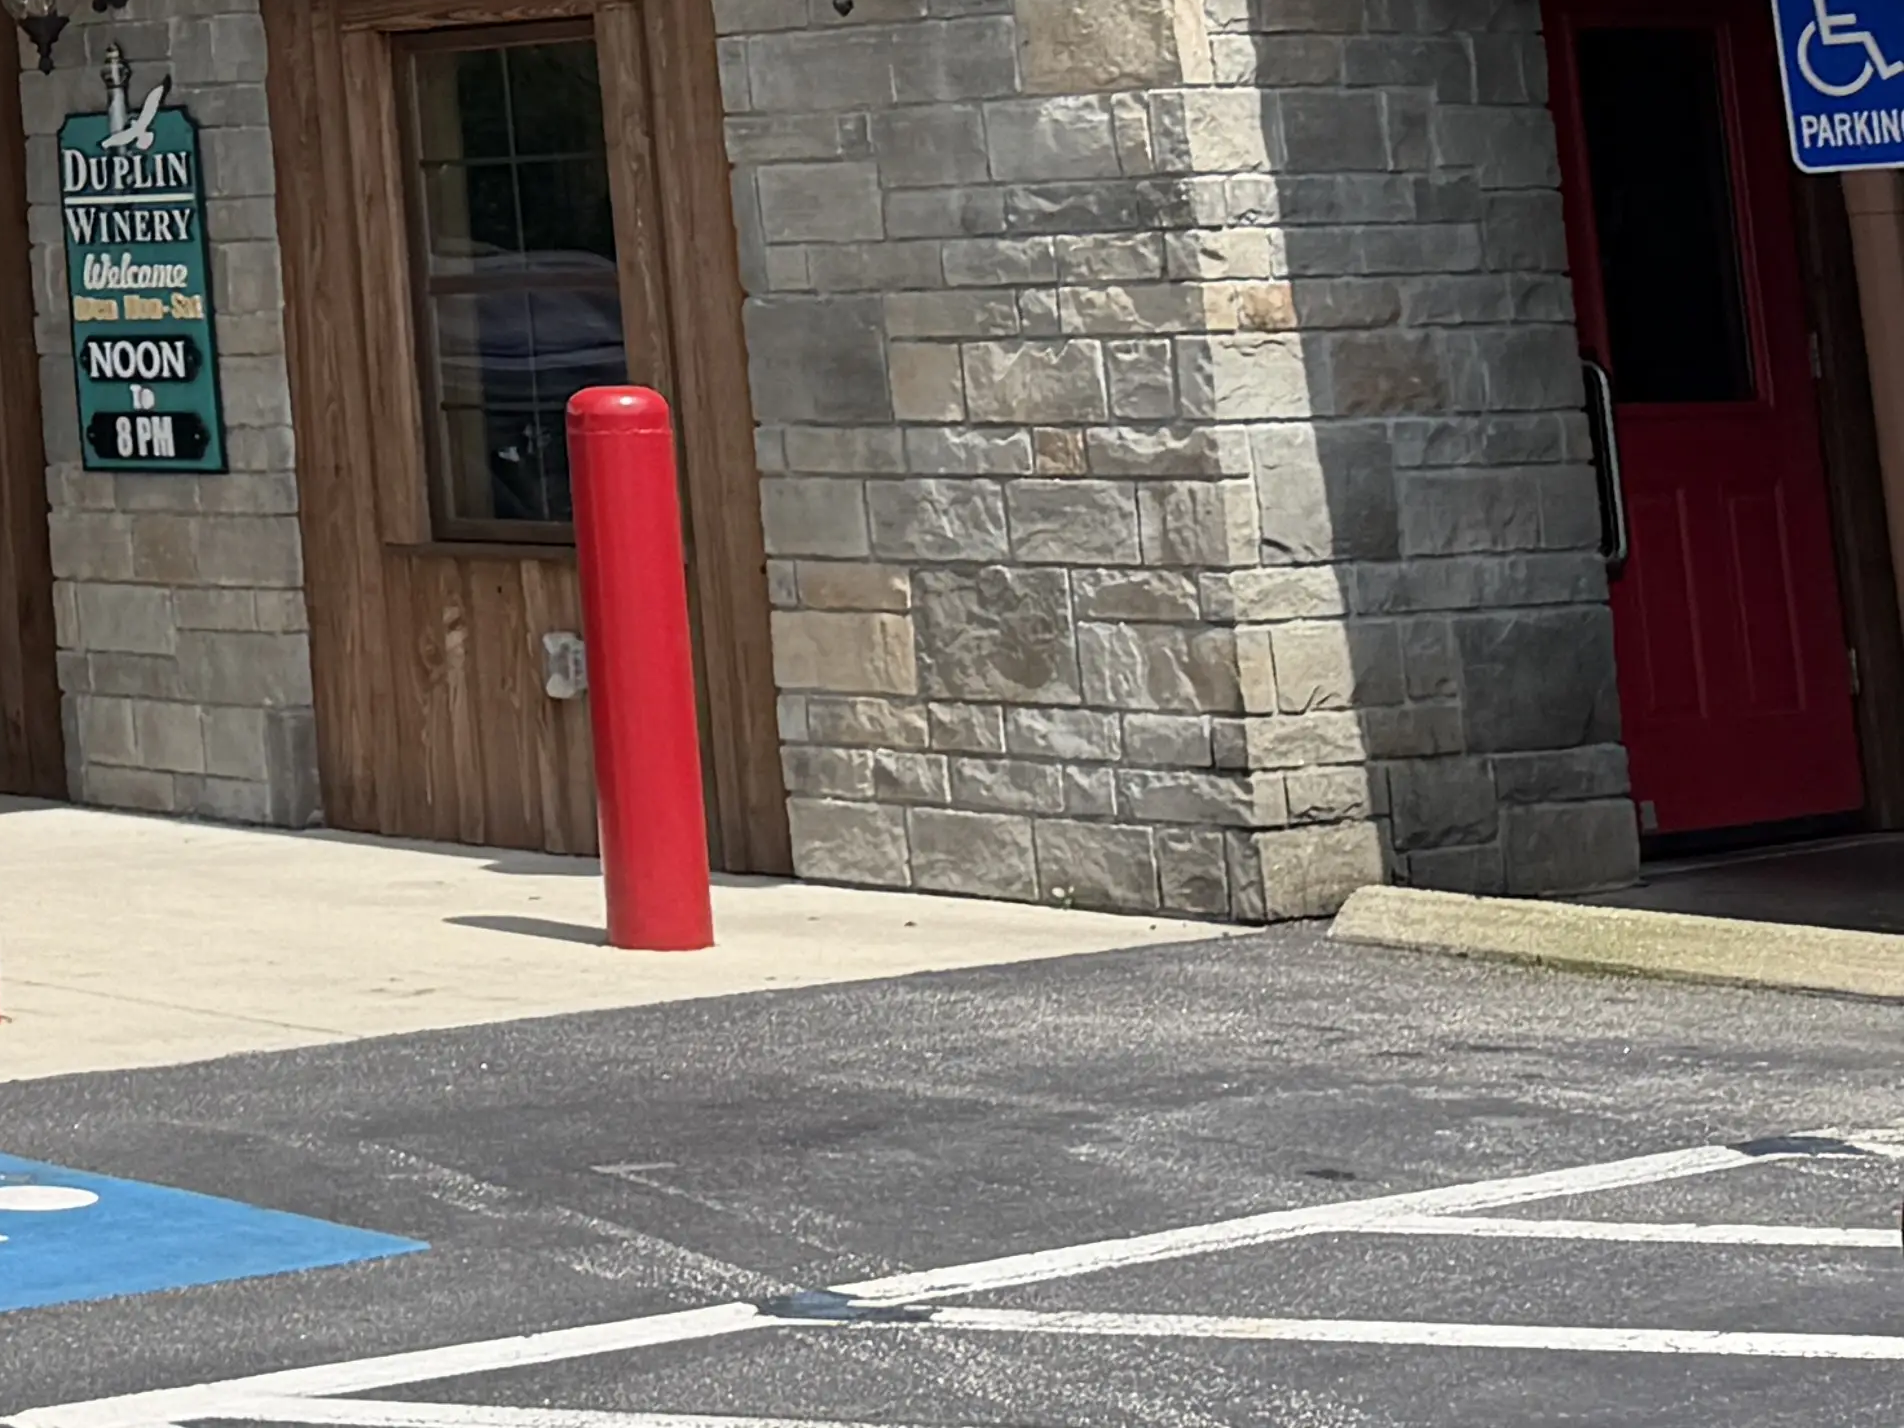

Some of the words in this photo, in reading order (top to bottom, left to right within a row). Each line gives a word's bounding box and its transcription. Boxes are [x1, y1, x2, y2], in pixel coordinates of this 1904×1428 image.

[1799, 107, 1904, 149] PARKIN
[62, 148, 190, 193] DUPLIN
[64, 206, 191, 245] WINERY
[83, 251, 188, 290] Welcome
[88, 340, 186, 379] NOON
[115, 415, 133, 458] 8
[136, 415, 176, 458] PM
